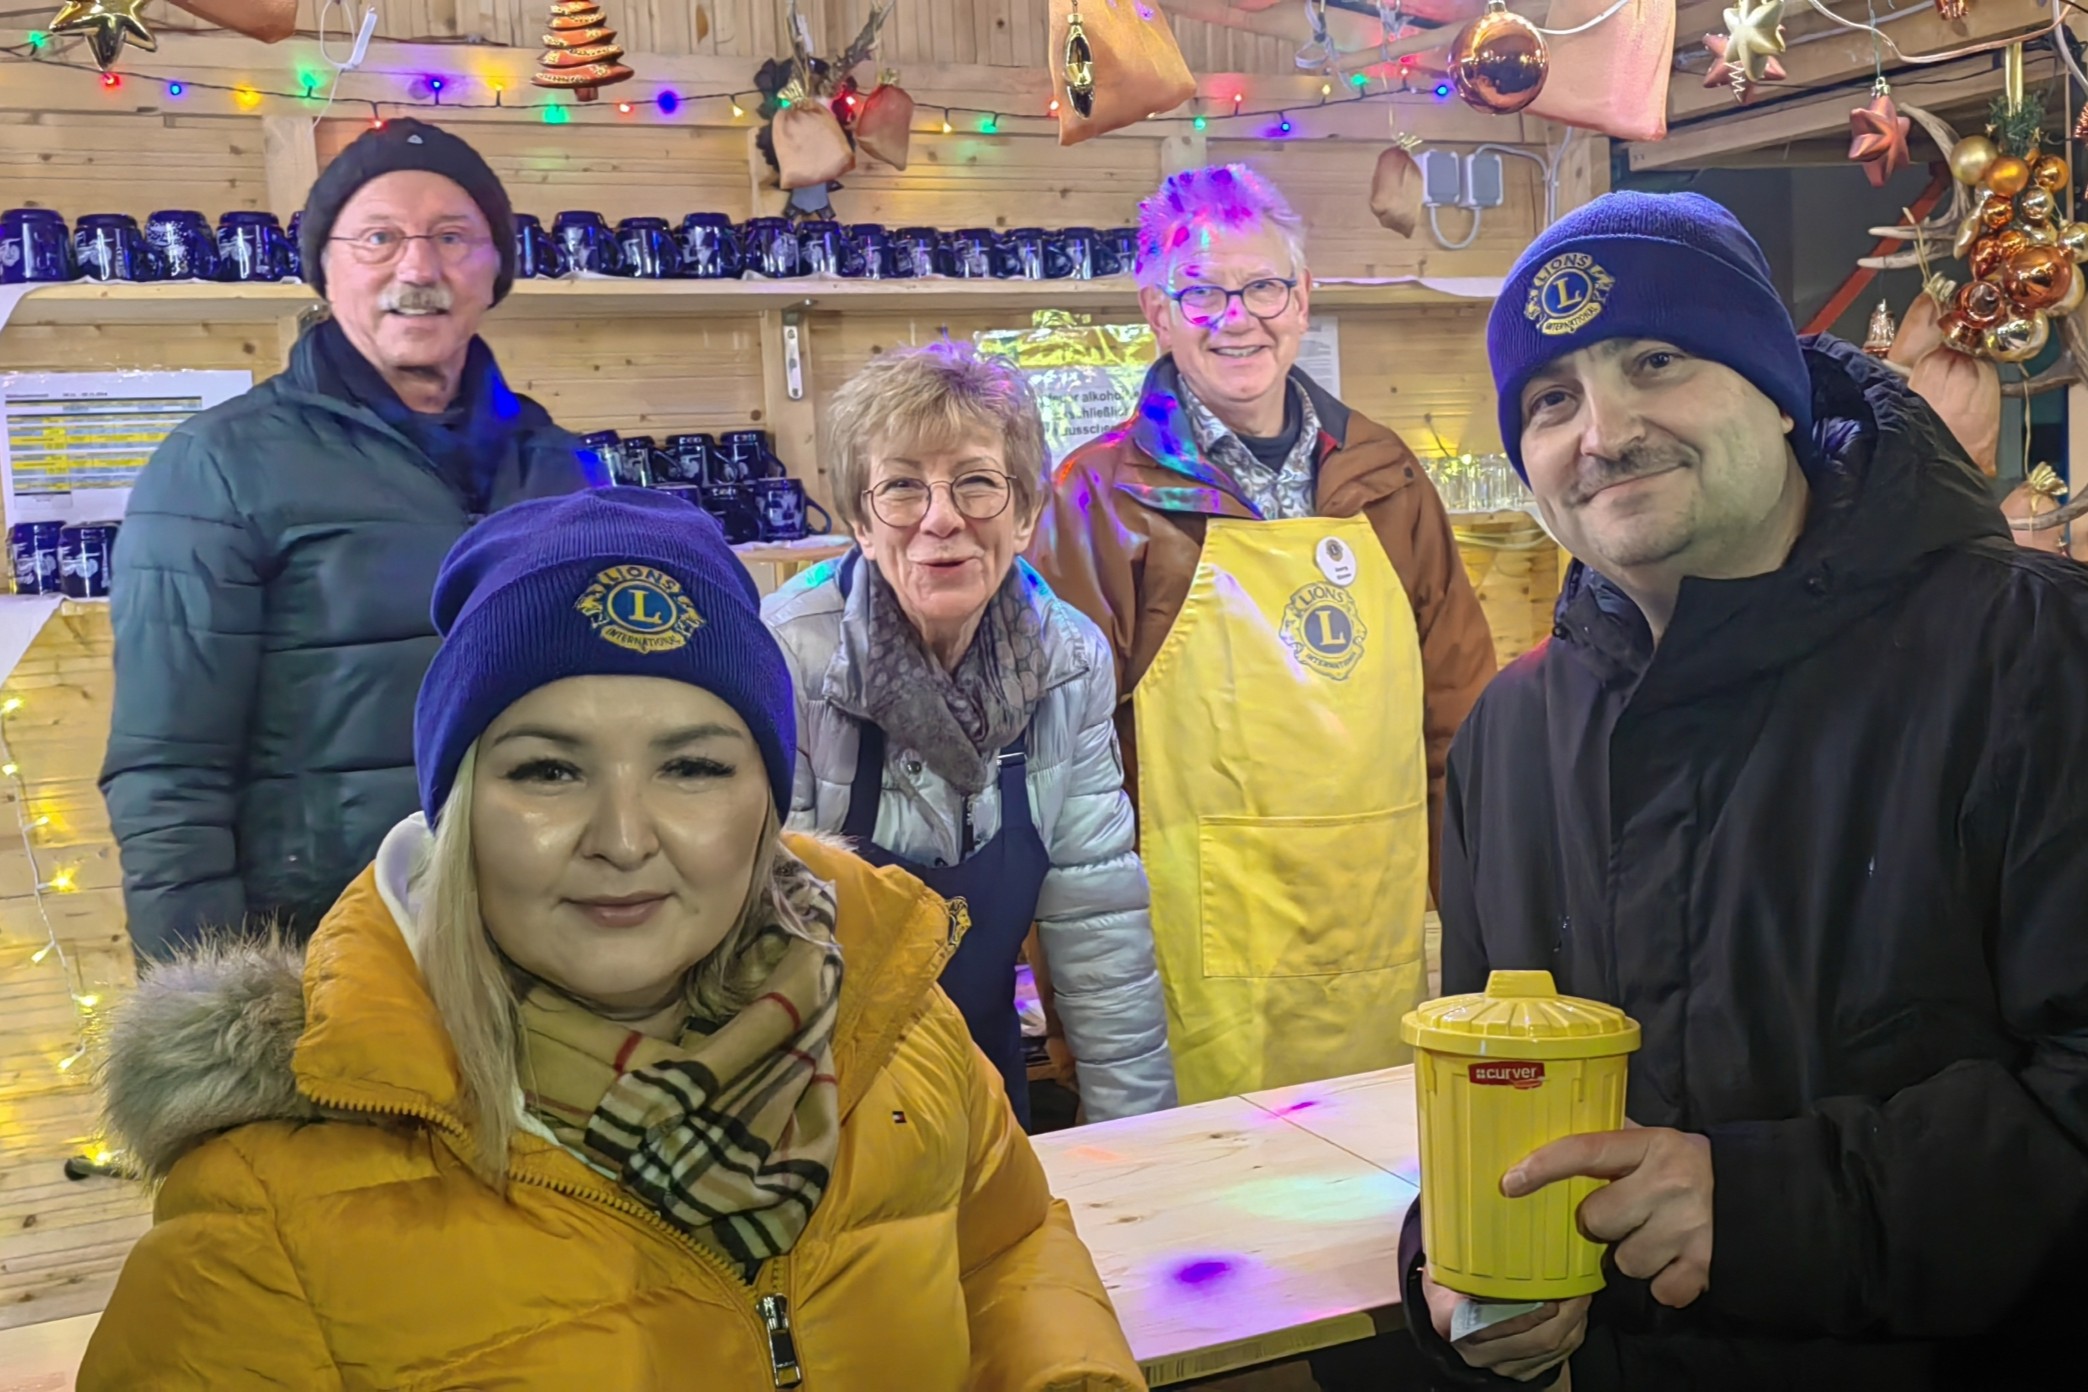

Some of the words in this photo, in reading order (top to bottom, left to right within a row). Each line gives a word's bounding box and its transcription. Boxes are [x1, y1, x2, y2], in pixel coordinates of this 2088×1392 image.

[1535, 253, 1589, 281] LIONS
[1552, 276, 1582, 309] L
[603, 566, 677, 592] LIONS
[628, 588, 662, 624] L
[1299, 586, 1344, 606] LIONS
[1314, 610, 1347, 646] L
[1486, 1066, 1537, 1080] curver
